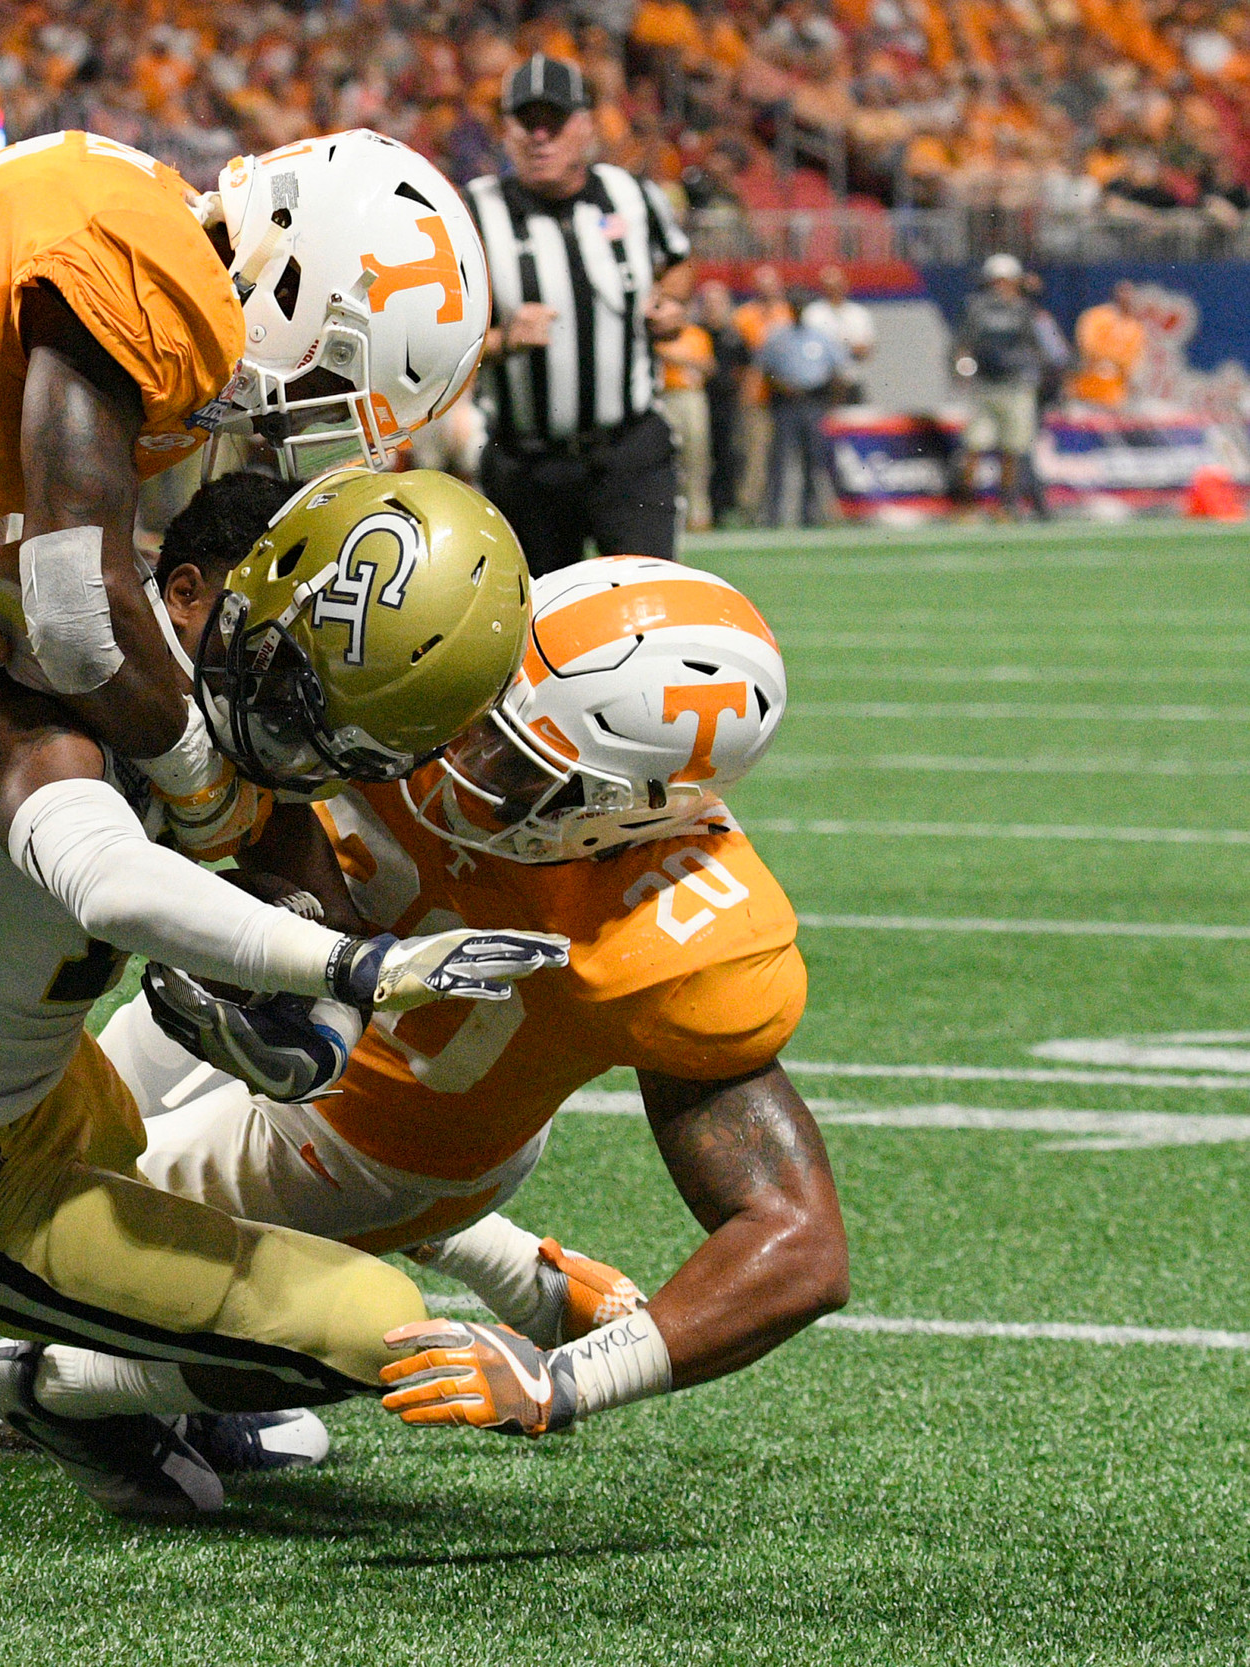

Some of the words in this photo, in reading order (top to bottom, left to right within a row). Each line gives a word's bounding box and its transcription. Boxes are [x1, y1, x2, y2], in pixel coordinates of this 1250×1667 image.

[359, 215, 464, 324] T
[310, 511, 420, 666] GT
[661, 680, 747, 784] T
[623, 846, 750, 946] 20
